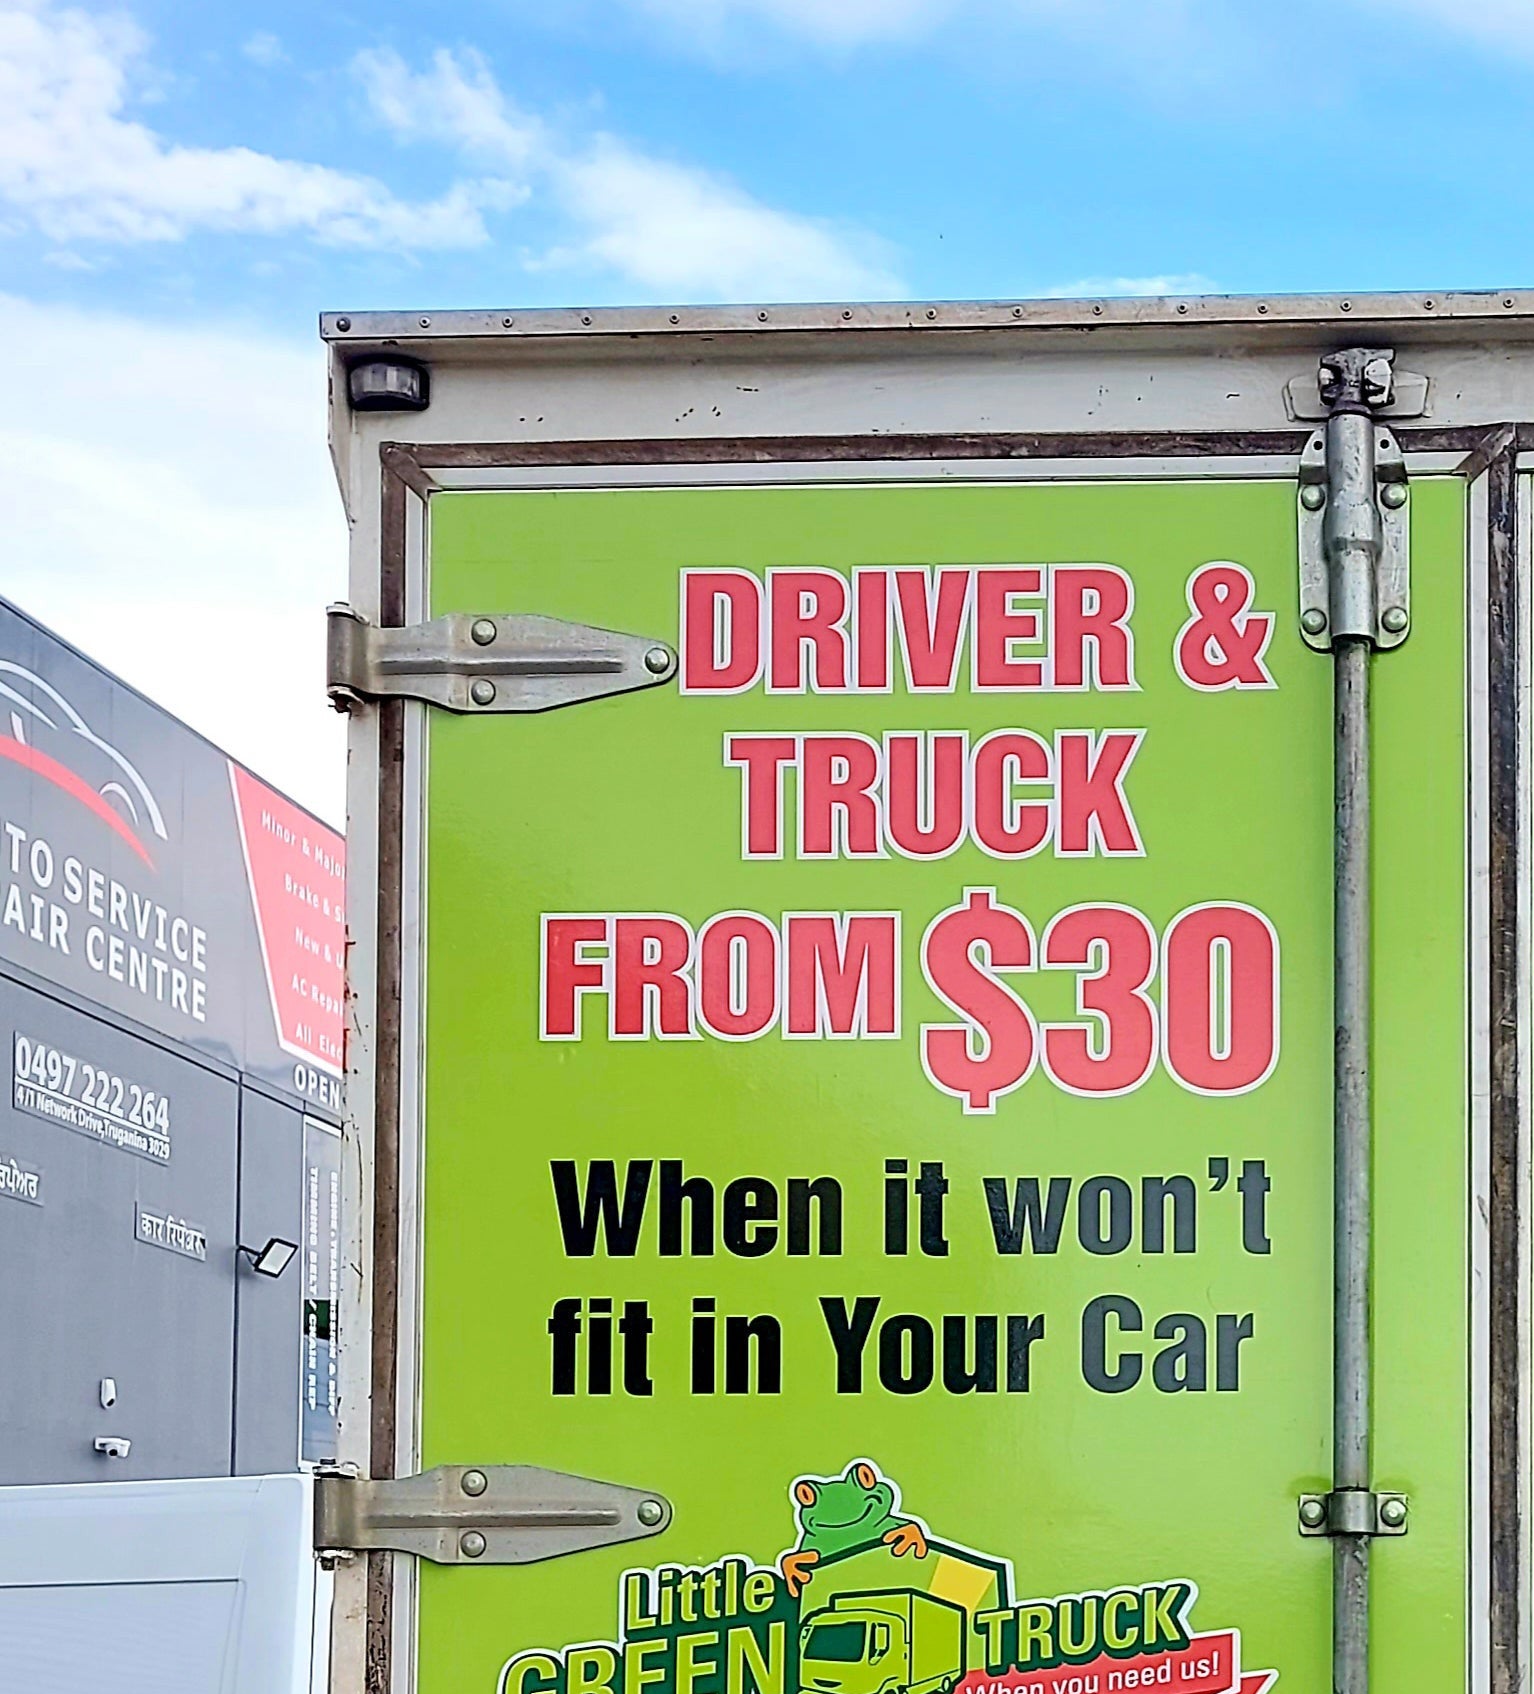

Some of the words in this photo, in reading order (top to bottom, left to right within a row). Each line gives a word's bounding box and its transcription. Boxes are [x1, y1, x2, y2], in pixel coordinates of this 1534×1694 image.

[679, 563, 1142, 695] DRIVER
[1174, 561, 1278, 691] &
[262, 810, 295, 846] Minor
[723, 728, 1147, 861] TRUCK
[5, 821, 54, 888] TO
[63, 856, 207, 972] SERVICE
[284, 872, 319, 909] Brake
[3, 883, 70, 955] AIR
[86, 926, 207, 1023] CENTRE
[296, 926, 319, 956] New
[292, 974, 307, 997] AC
[540, 909, 902, 1041] FROM
[920, 886, 1280, 1115] $30
[296, 1021, 311, 1046] All
[16, 1037, 77, 1096] 0497
[81, 1065, 125, 1118] 222
[129, 1084, 170, 1136] 264
[293, 1063, 341, 1109] OPEN
[37, 1092, 78, 1125] Network
[148, 1136, 170, 1160] 3029
[549, 1158, 843, 1258] When
[883, 1157, 949, 1257] it
[984, 1156, 1272, 1255] won't
[309, 1250, 318, 1295] BELT
[308, 1313, 317, 1369] CHAIN
[547, 1297, 655, 1396] fit
[691, 1297, 782, 1396] in
[819, 1296, 1044, 1395] Your
[1080, 1294, 1254, 1393] Car
[626, 1559, 776, 1631] Little
[976, 1584, 1184, 1668] TRUCK
[1108, 1659, 1172, 1691] need
[1180, 1651, 1220, 1681] us!
